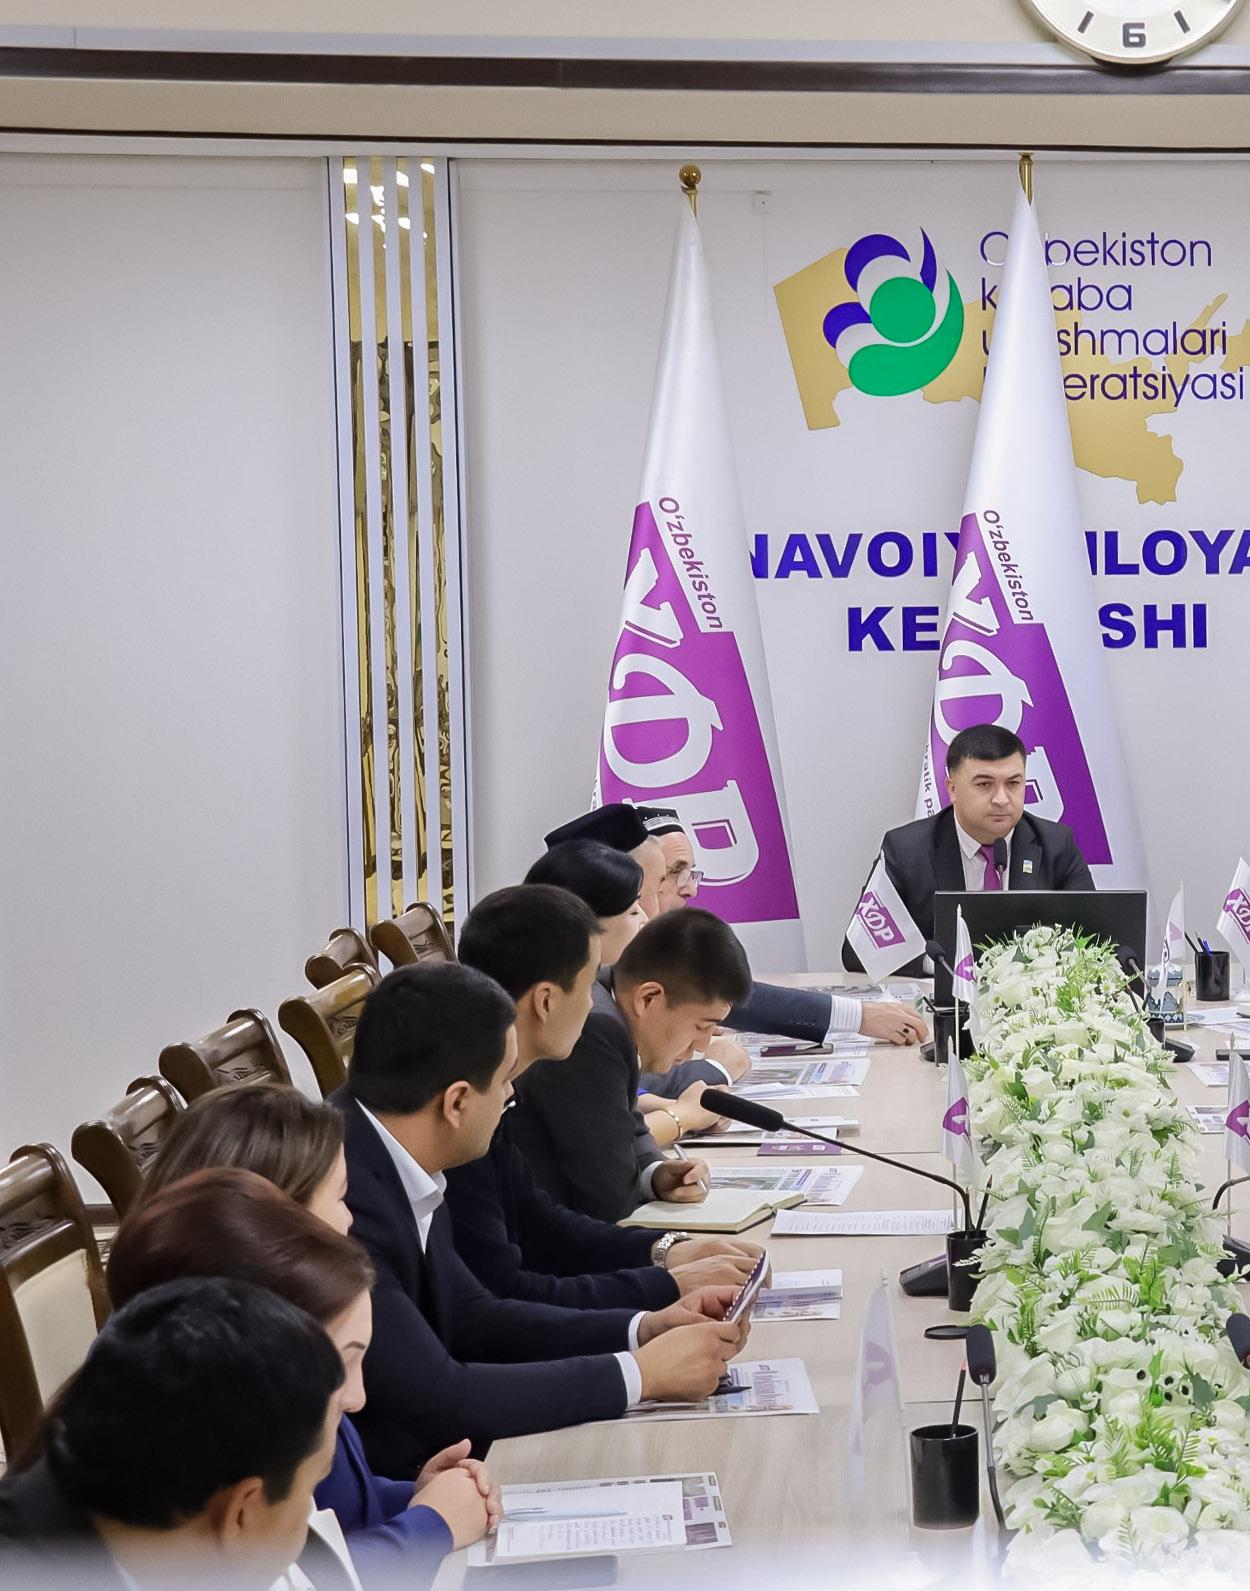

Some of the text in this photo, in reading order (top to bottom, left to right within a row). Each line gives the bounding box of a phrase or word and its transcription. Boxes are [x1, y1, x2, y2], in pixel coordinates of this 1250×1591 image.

[1122, 22, 1147, 48] 6
[979, 231, 1212, 268] Obekiston
[981, 277, 1132, 311] kaba
[982, 321, 1227, 356] shmalari
[984, 366, 1244, 408] eratsiyasi
[847, 603, 1208, 652] KESHI
[858, 897, 895, 941] XDP
